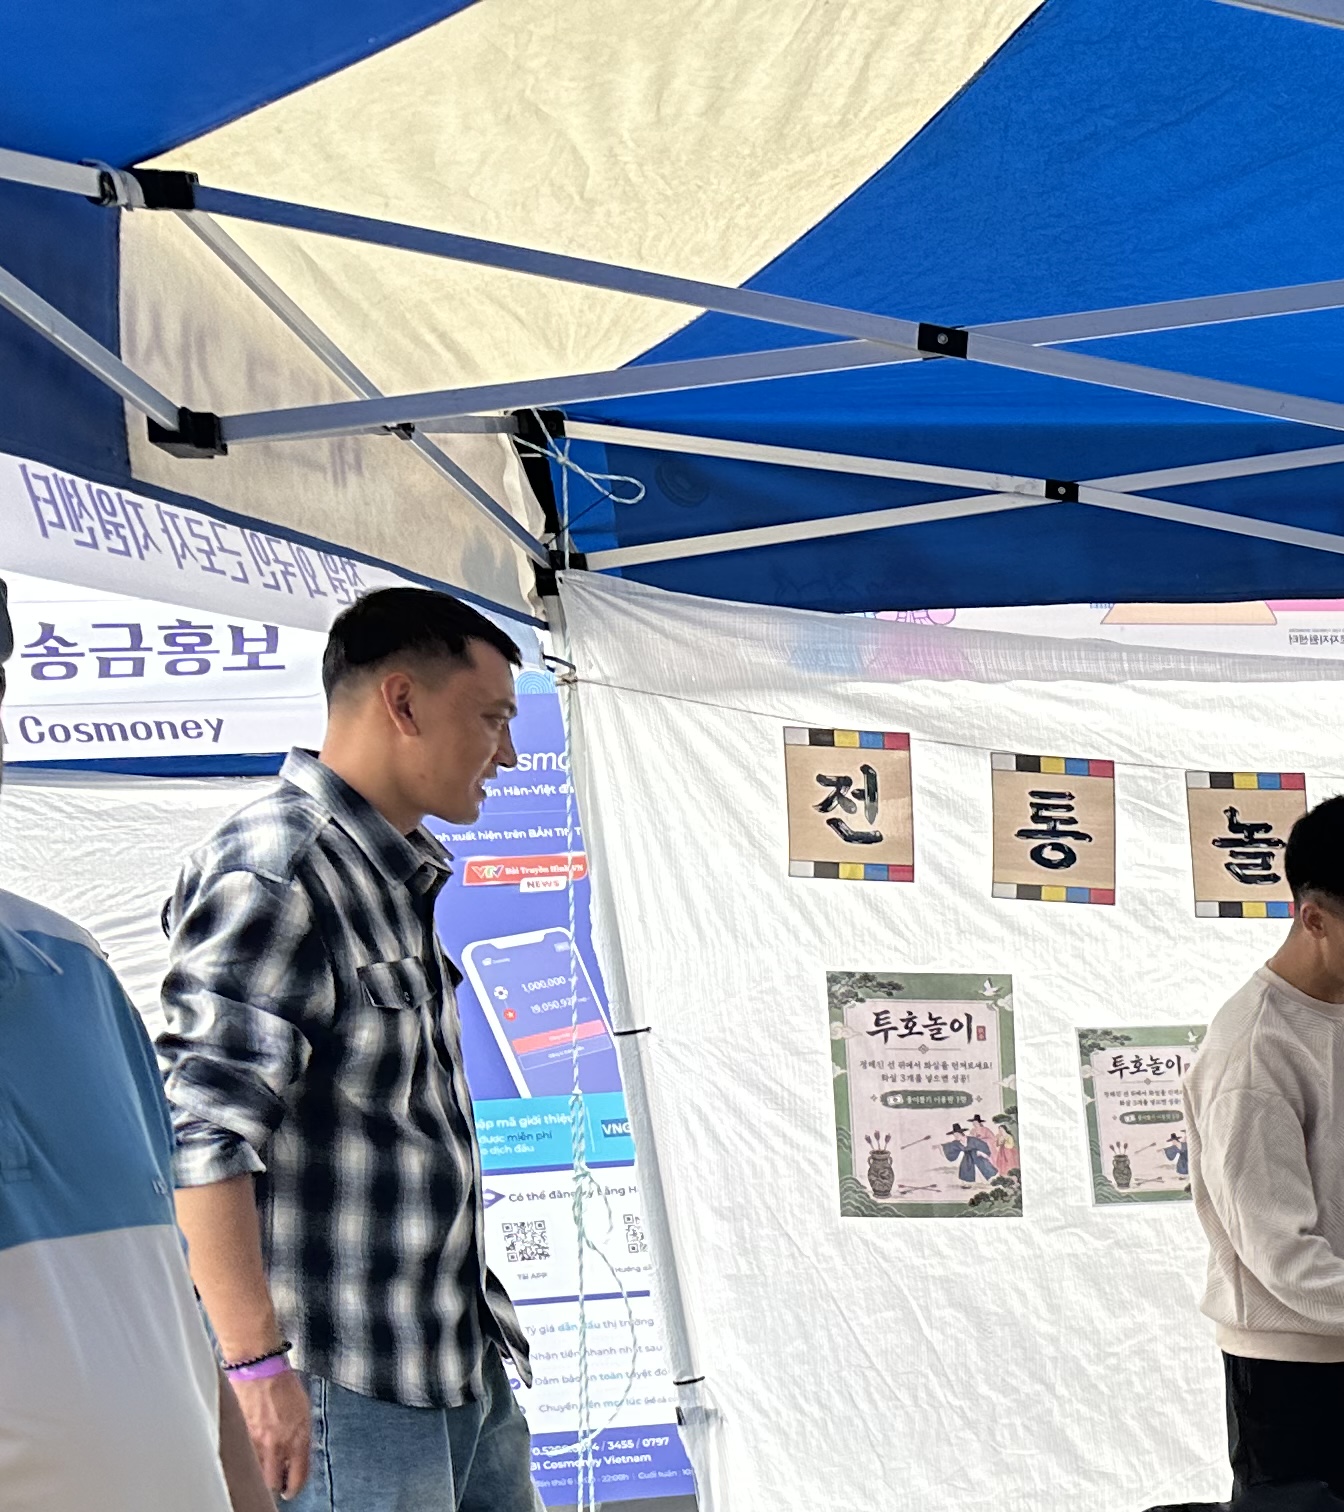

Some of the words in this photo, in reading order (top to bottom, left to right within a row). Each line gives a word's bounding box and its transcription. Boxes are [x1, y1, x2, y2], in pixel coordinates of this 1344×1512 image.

[20, 618, 286, 681] 송금홍보
[19, 713, 226, 745] Cosmoney
[866, 1009, 973, 1044] 투호놀이
[1107, 1054, 1182, 1079] 투호놀이
[642, 1436, 670, 1448] 0797
[603, 1454, 652, 1466] Vietnam
